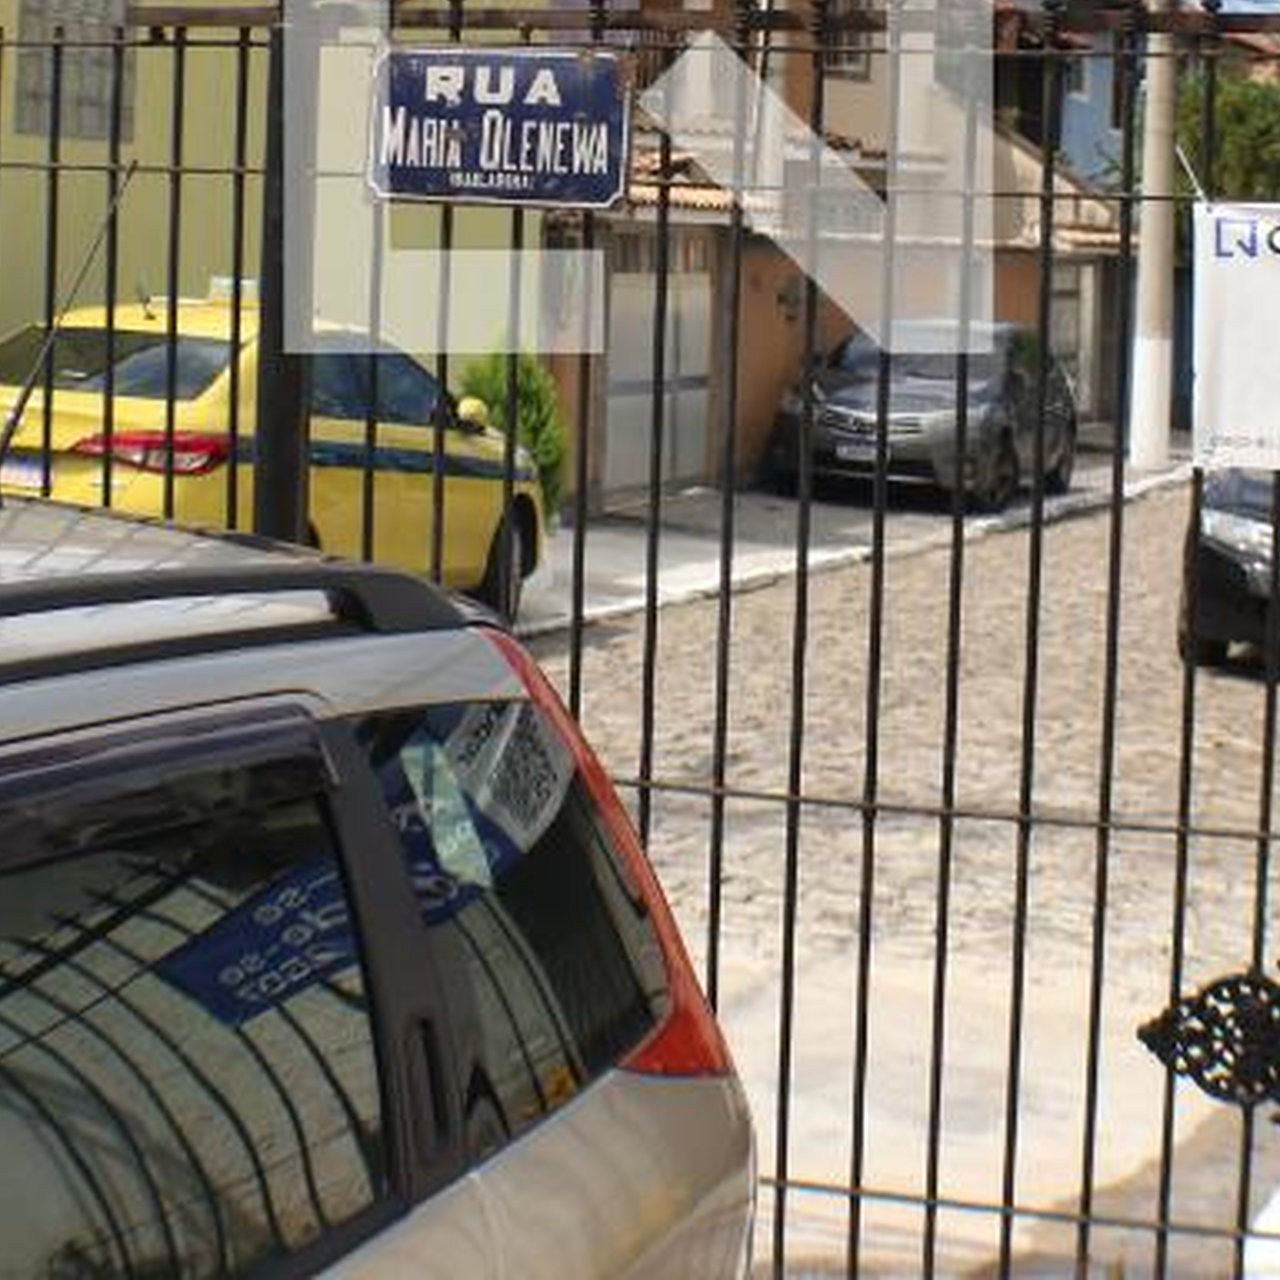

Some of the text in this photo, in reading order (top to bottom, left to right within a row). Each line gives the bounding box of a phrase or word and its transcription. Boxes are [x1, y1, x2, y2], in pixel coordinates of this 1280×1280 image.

[425, 65, 562, 107] RUA
[380, 105, 609, 175] MARIA OLENEWA
